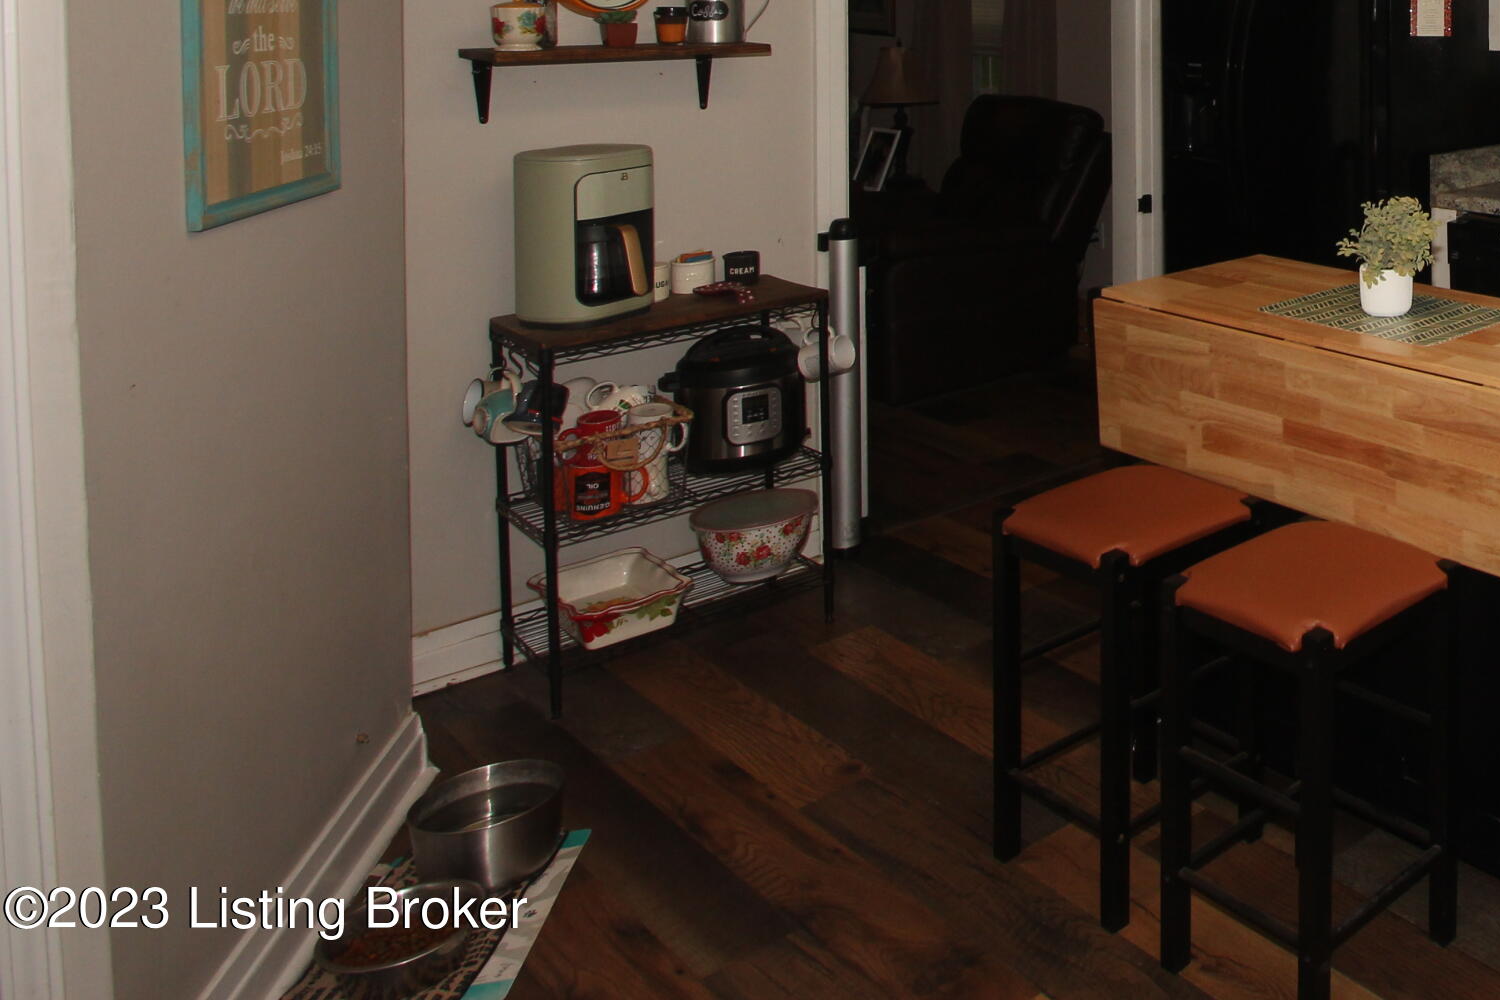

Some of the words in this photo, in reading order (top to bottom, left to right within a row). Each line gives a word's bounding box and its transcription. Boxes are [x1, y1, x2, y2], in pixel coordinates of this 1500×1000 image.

[253, 25, 276, 51] the
[215, 58, 307, 122] LORD
[729, 267, 755, 276] CREAM
[585, 482, 600, 490] OIL
[576, 501, 611, 512] GENUINE
